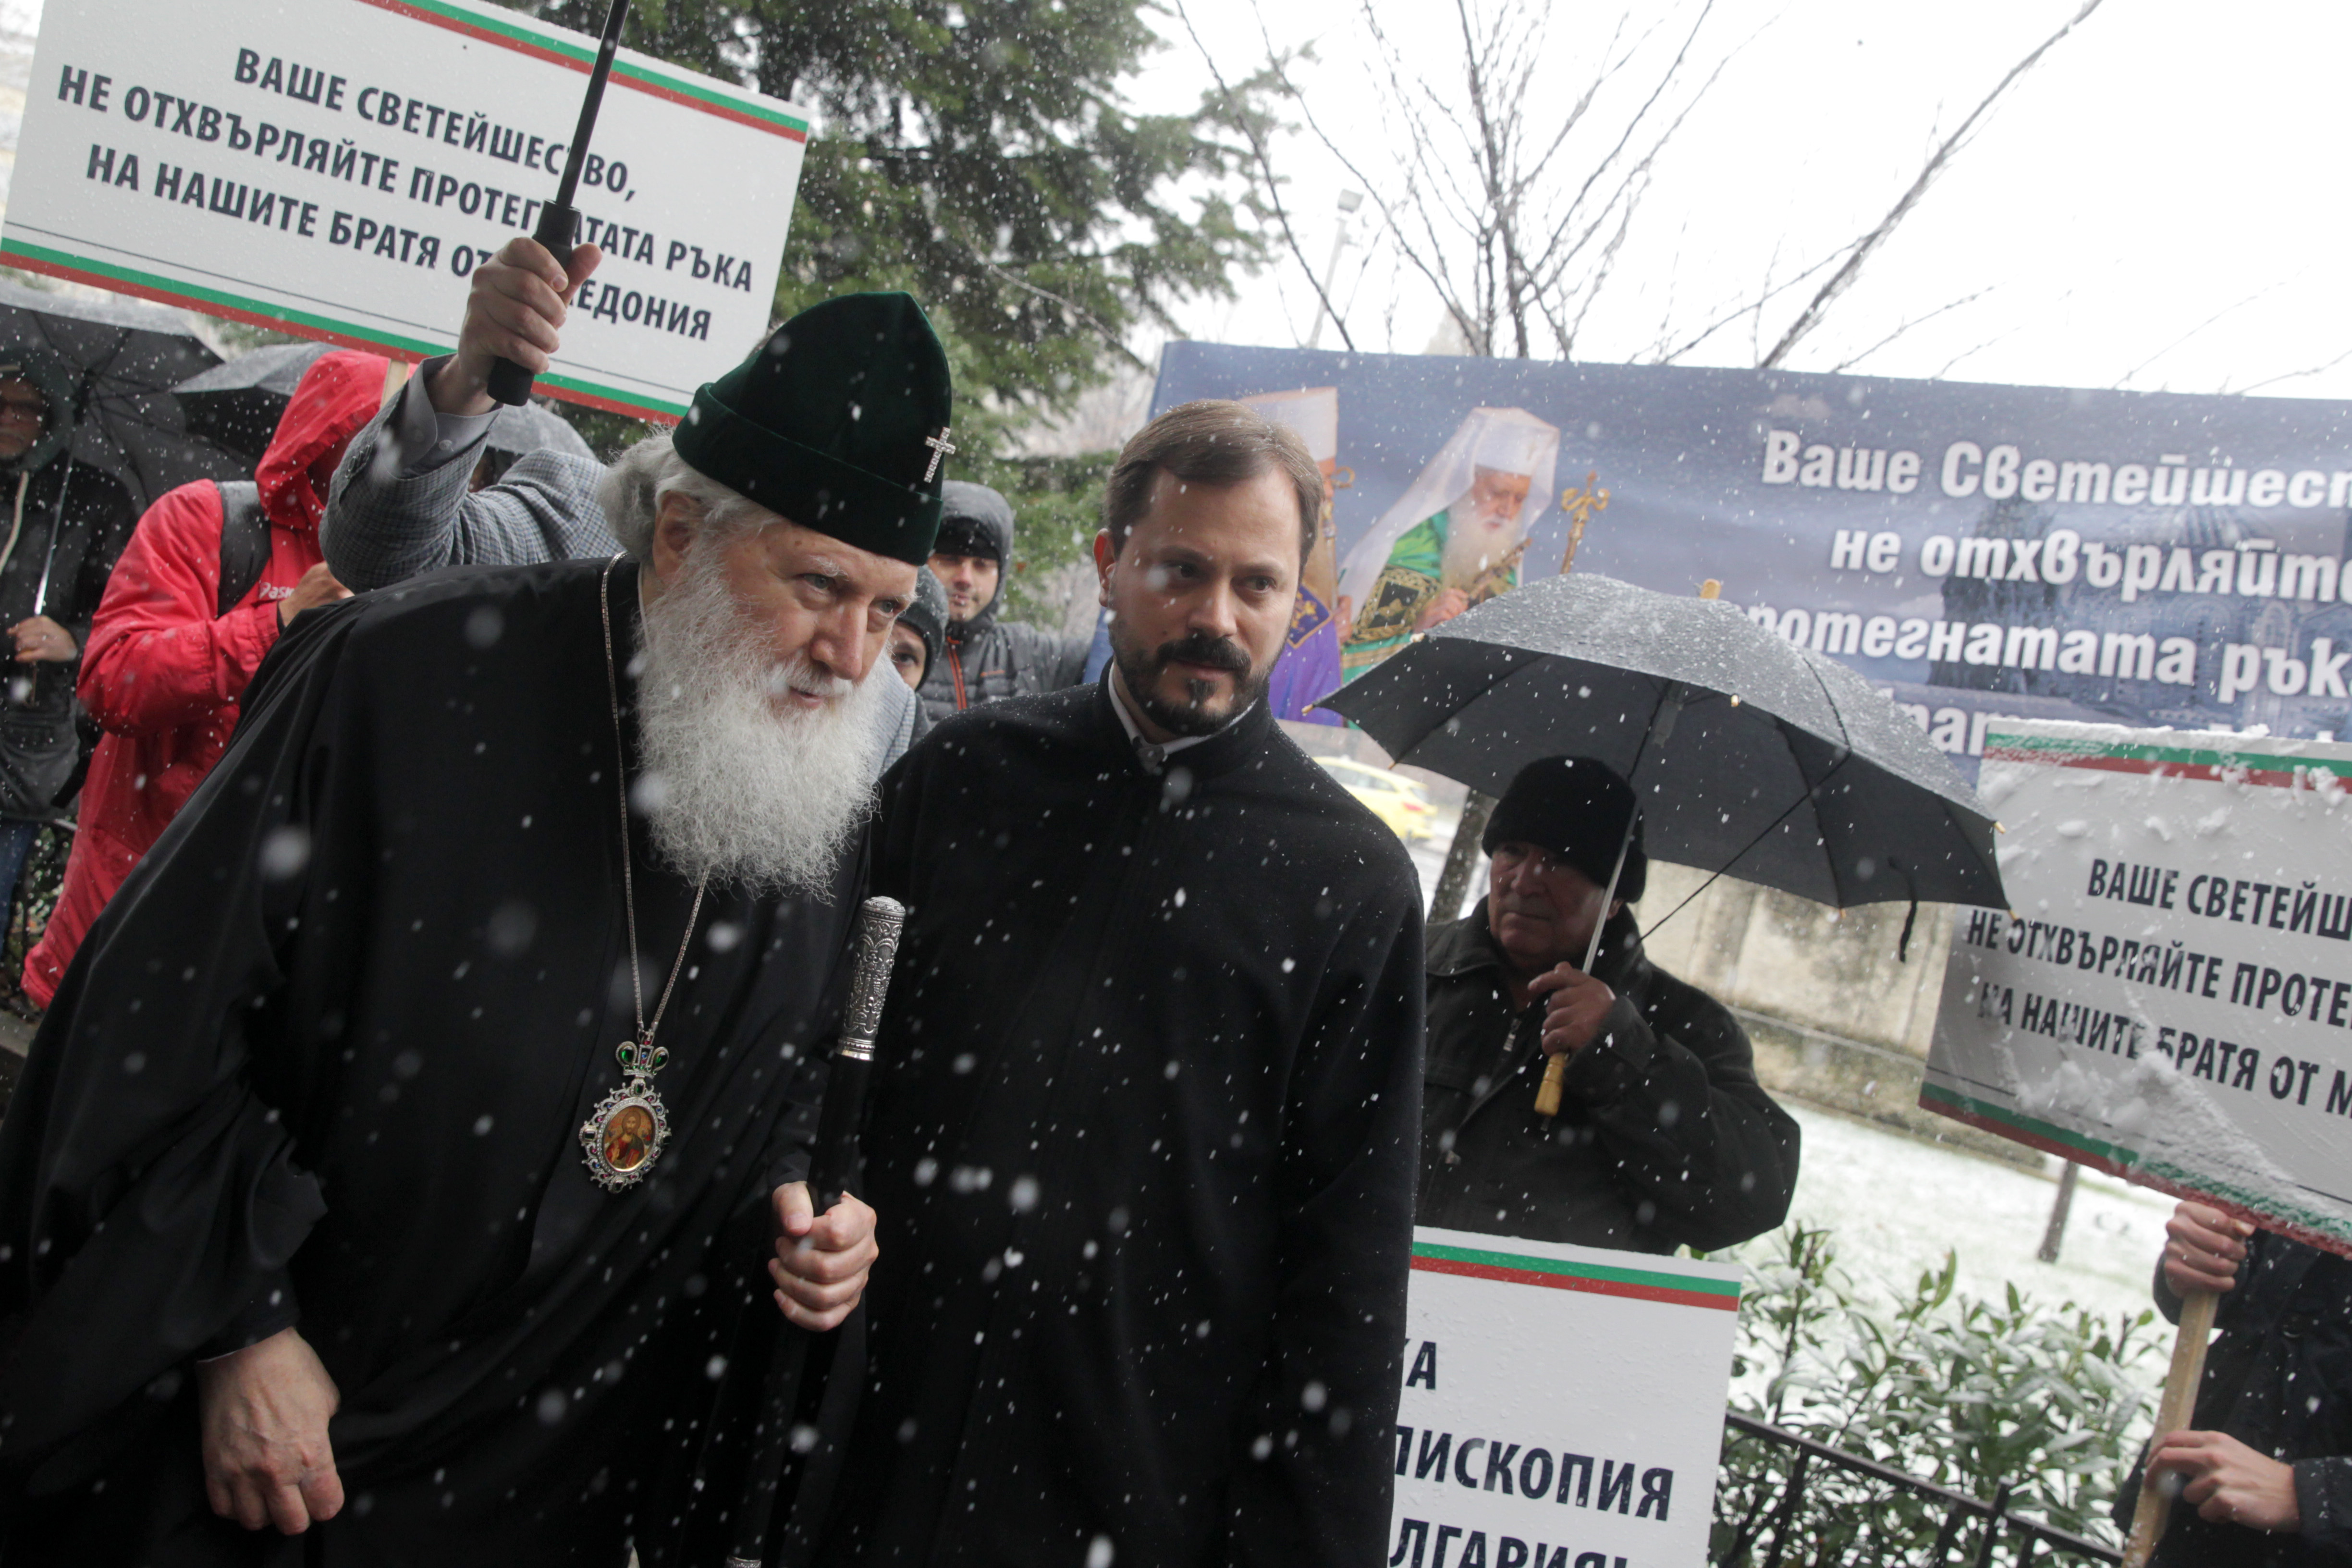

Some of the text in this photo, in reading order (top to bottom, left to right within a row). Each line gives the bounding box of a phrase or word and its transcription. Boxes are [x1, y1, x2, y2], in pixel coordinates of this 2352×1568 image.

[234, 48, 635, 202] ВАШЕ СВЕТЕЙШЕСВО,
[57, 64, 751, 292] НЕ ОТХВЪРЛЯЙТЕ ПРОТЕГТАТА РЪКА
[86, 145, 139, 191] НА
[154, 163, 318, 237] НАШИТЕ
[329, 210, 440, 270] БРАТЯ
[569, 279, 711, 341] ЕДОНИЯ
[1762, 430, 1922, 493] Ваше
[1831, 529, 1901, 573] не
[1747, 604, 2352, 703] отегнатата рък
[2087, 859, 2179, 909] ВАШЕ
[1967, 909, 2352, 1030] НЕ ОТХВЪРЛЯЙТЕ ПРОТЕ
[2157, 1027, 2260, 1091] БРАТЯ
[2269, 1056, 2320, 1106] ОТ
[1405, 1338, 1436, 1390] А
